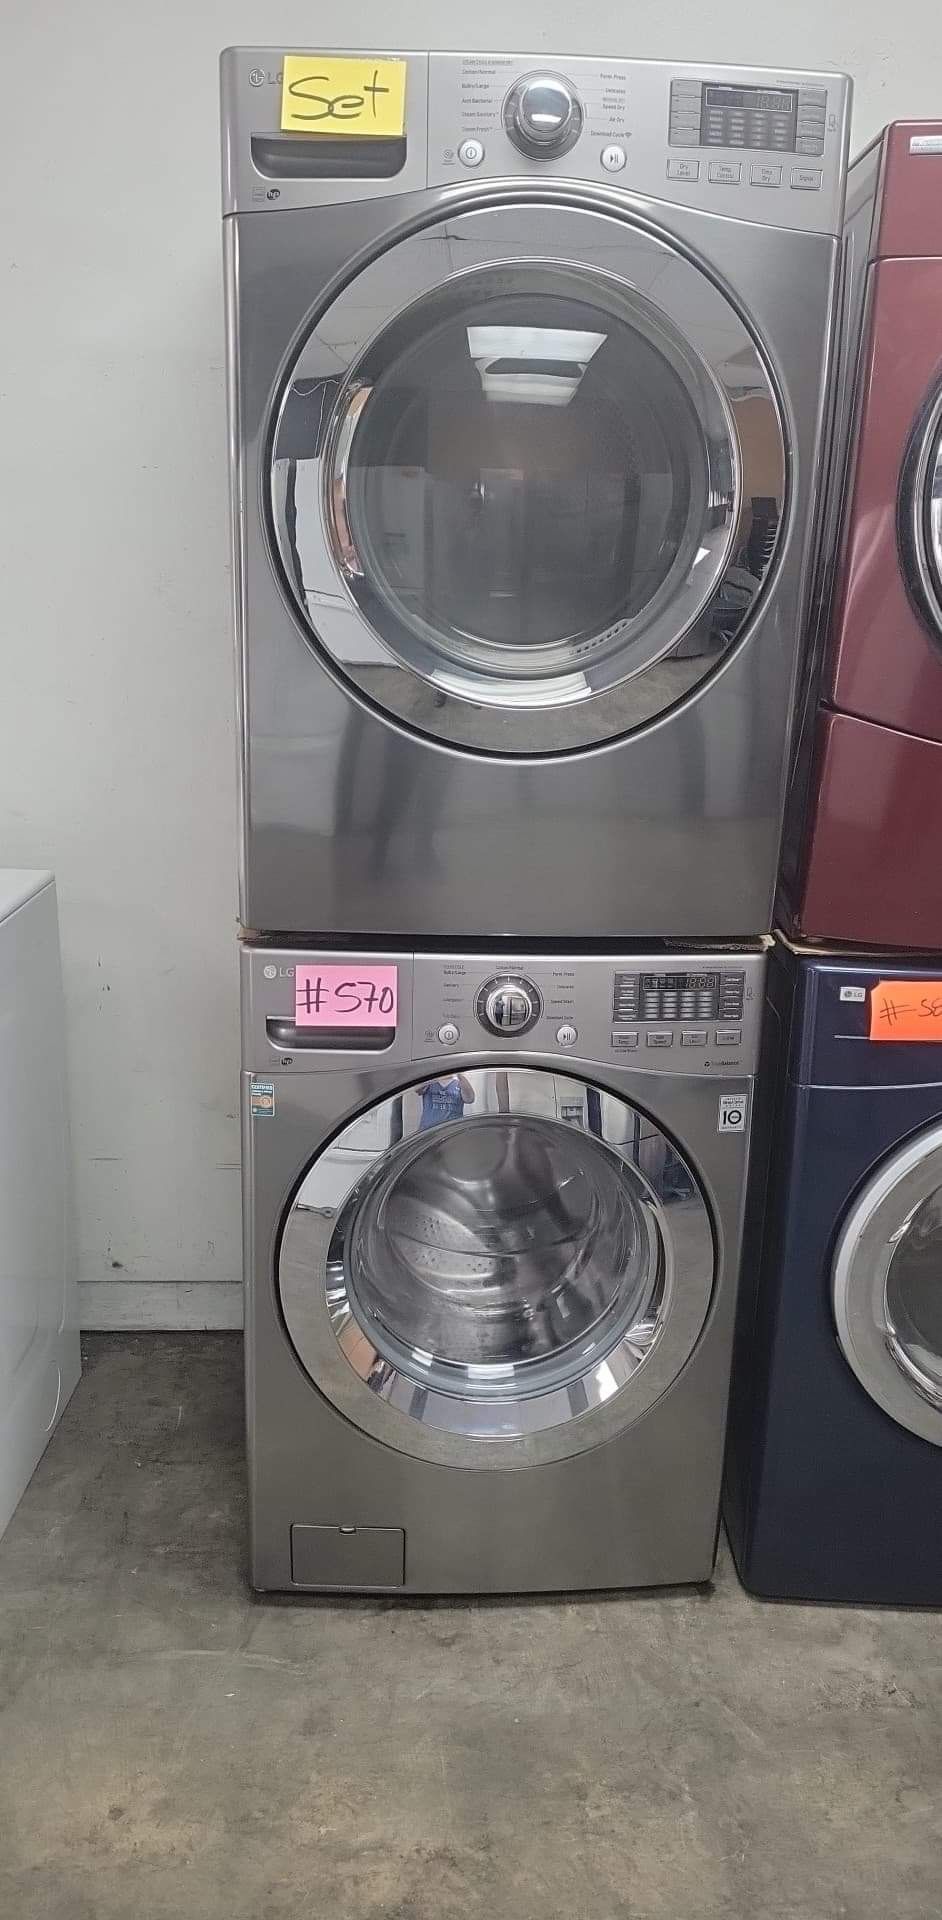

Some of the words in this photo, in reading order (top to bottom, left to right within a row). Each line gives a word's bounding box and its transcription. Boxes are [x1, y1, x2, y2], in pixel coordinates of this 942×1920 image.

[288, 69, 390, 121] Set
[279, 967, 295, 978] LG
[296, 977, 394, 1014] #570
[723, 1110, 742, 1125] 10
